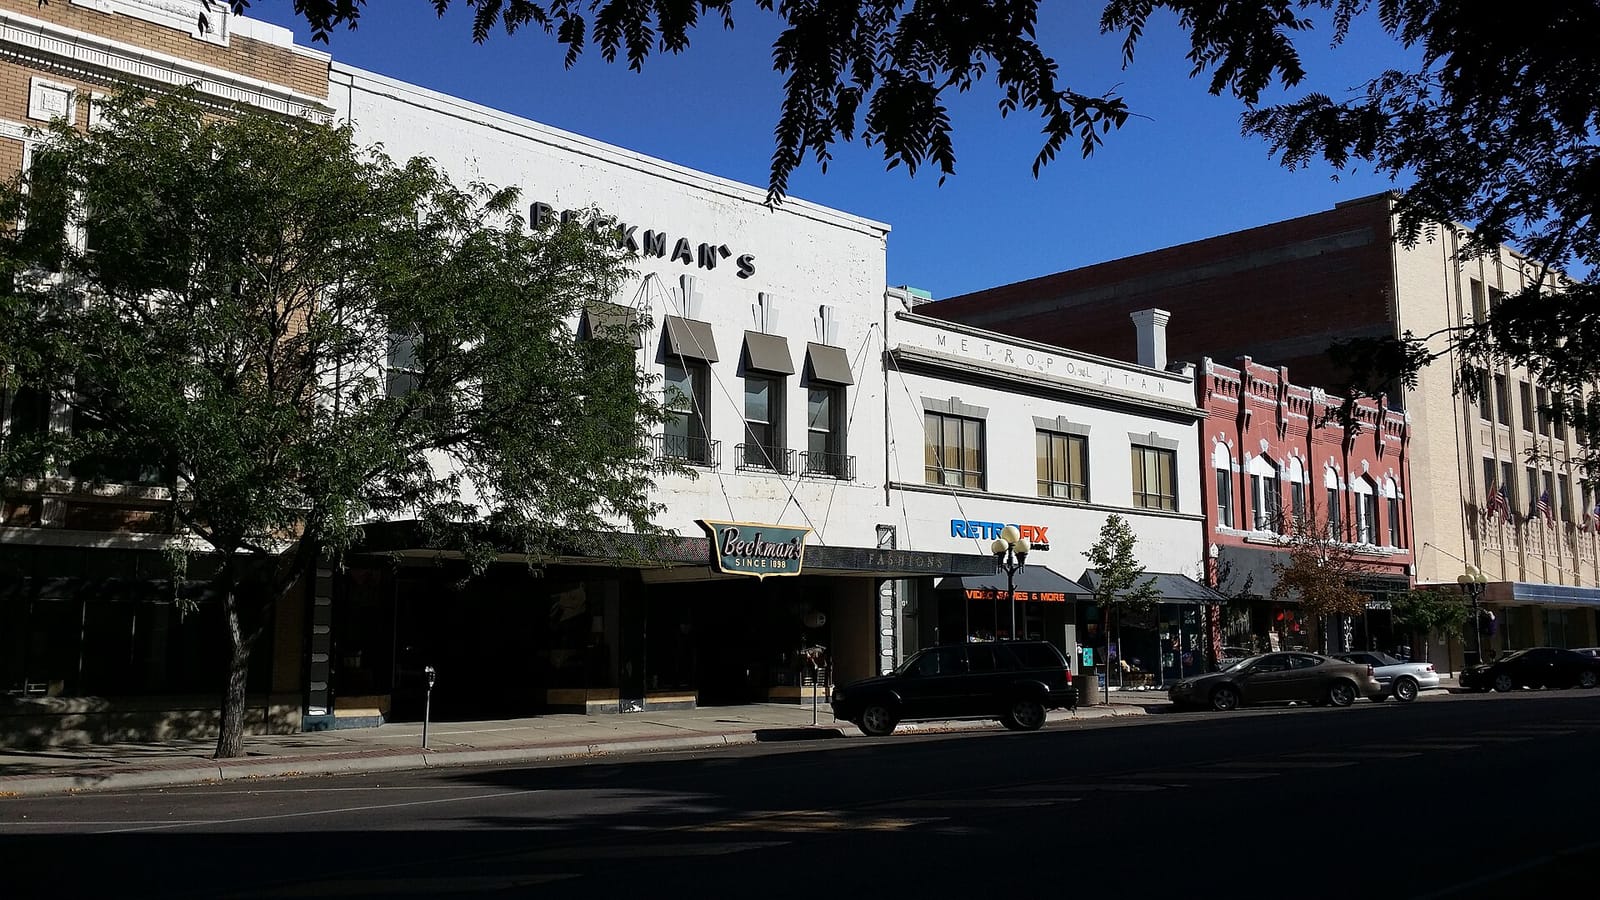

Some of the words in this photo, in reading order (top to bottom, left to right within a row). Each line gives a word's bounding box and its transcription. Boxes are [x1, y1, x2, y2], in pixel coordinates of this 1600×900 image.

[529, 201, 756, 280] BCKMAN'S
[936, 334, 1165, 393] METROPOLITAN
[721, 526, 803, 559] Beckman's
[951, 519, 1049, 544] RETRFIX
[735, 558, 766, 568] SINCE
[868, 553, 943, 568] FASHIONS
[965, 589, 994, 600] VIDEO
[1040, 593, 1065, 602] MORE
